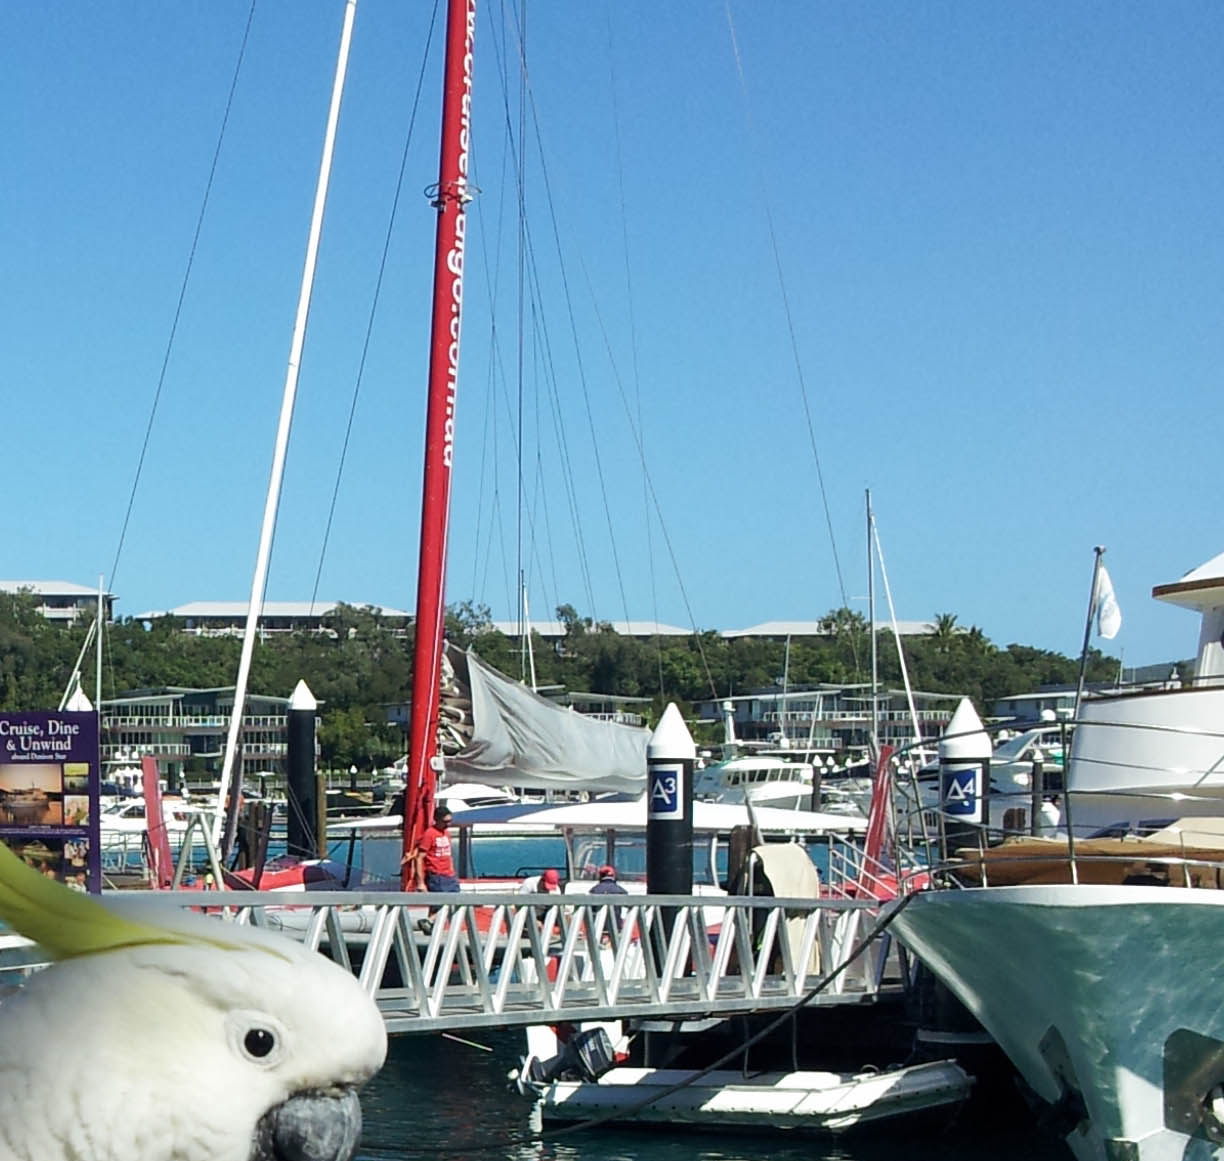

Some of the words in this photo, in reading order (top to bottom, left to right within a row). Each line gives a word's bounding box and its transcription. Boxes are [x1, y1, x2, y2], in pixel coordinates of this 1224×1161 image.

[48, 720, 80, 735] Dine
[6, 740, 16, 751] &
[20, 735, 72, 751] Unwind
[650, 777, 676, 805] A3
[946, 777, 975, 807] A4
